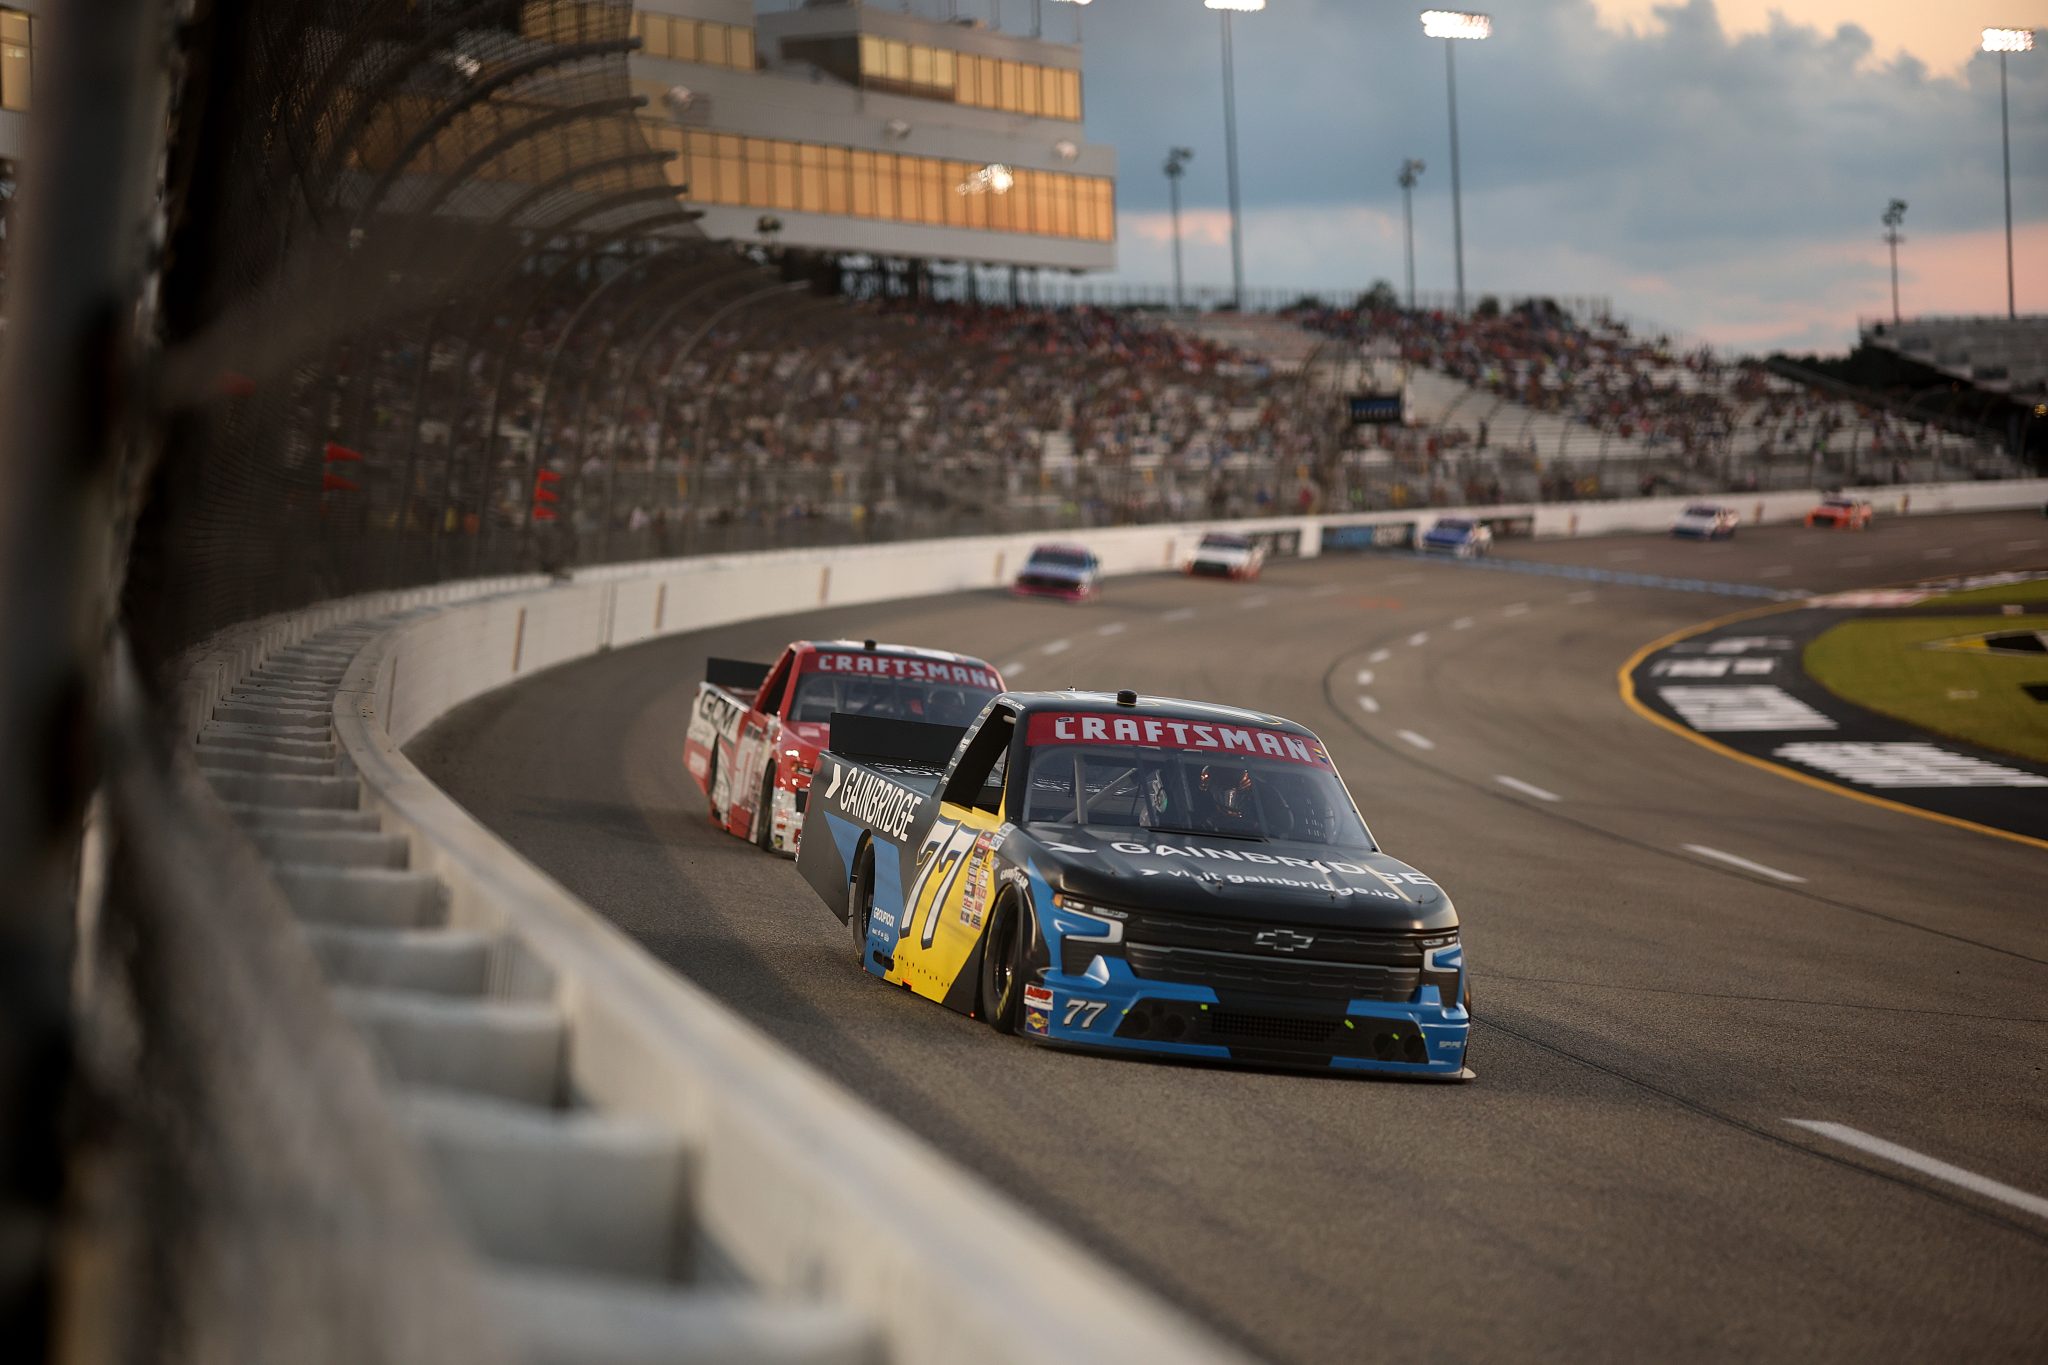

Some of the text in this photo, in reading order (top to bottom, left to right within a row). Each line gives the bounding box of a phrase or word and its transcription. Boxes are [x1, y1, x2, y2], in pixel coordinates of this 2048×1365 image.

[818, 654, 988, 687] CRAFTSMAN
[1055, 716, 1313, 763] CRAFTSMAN
[839, 766, 923, 842] GAINBRIDGE
[899, 813, 980, 951] 77
[1226, 874, 1399, 900] gainbridge.io
[1063, 999, 1108, 1030] 77
